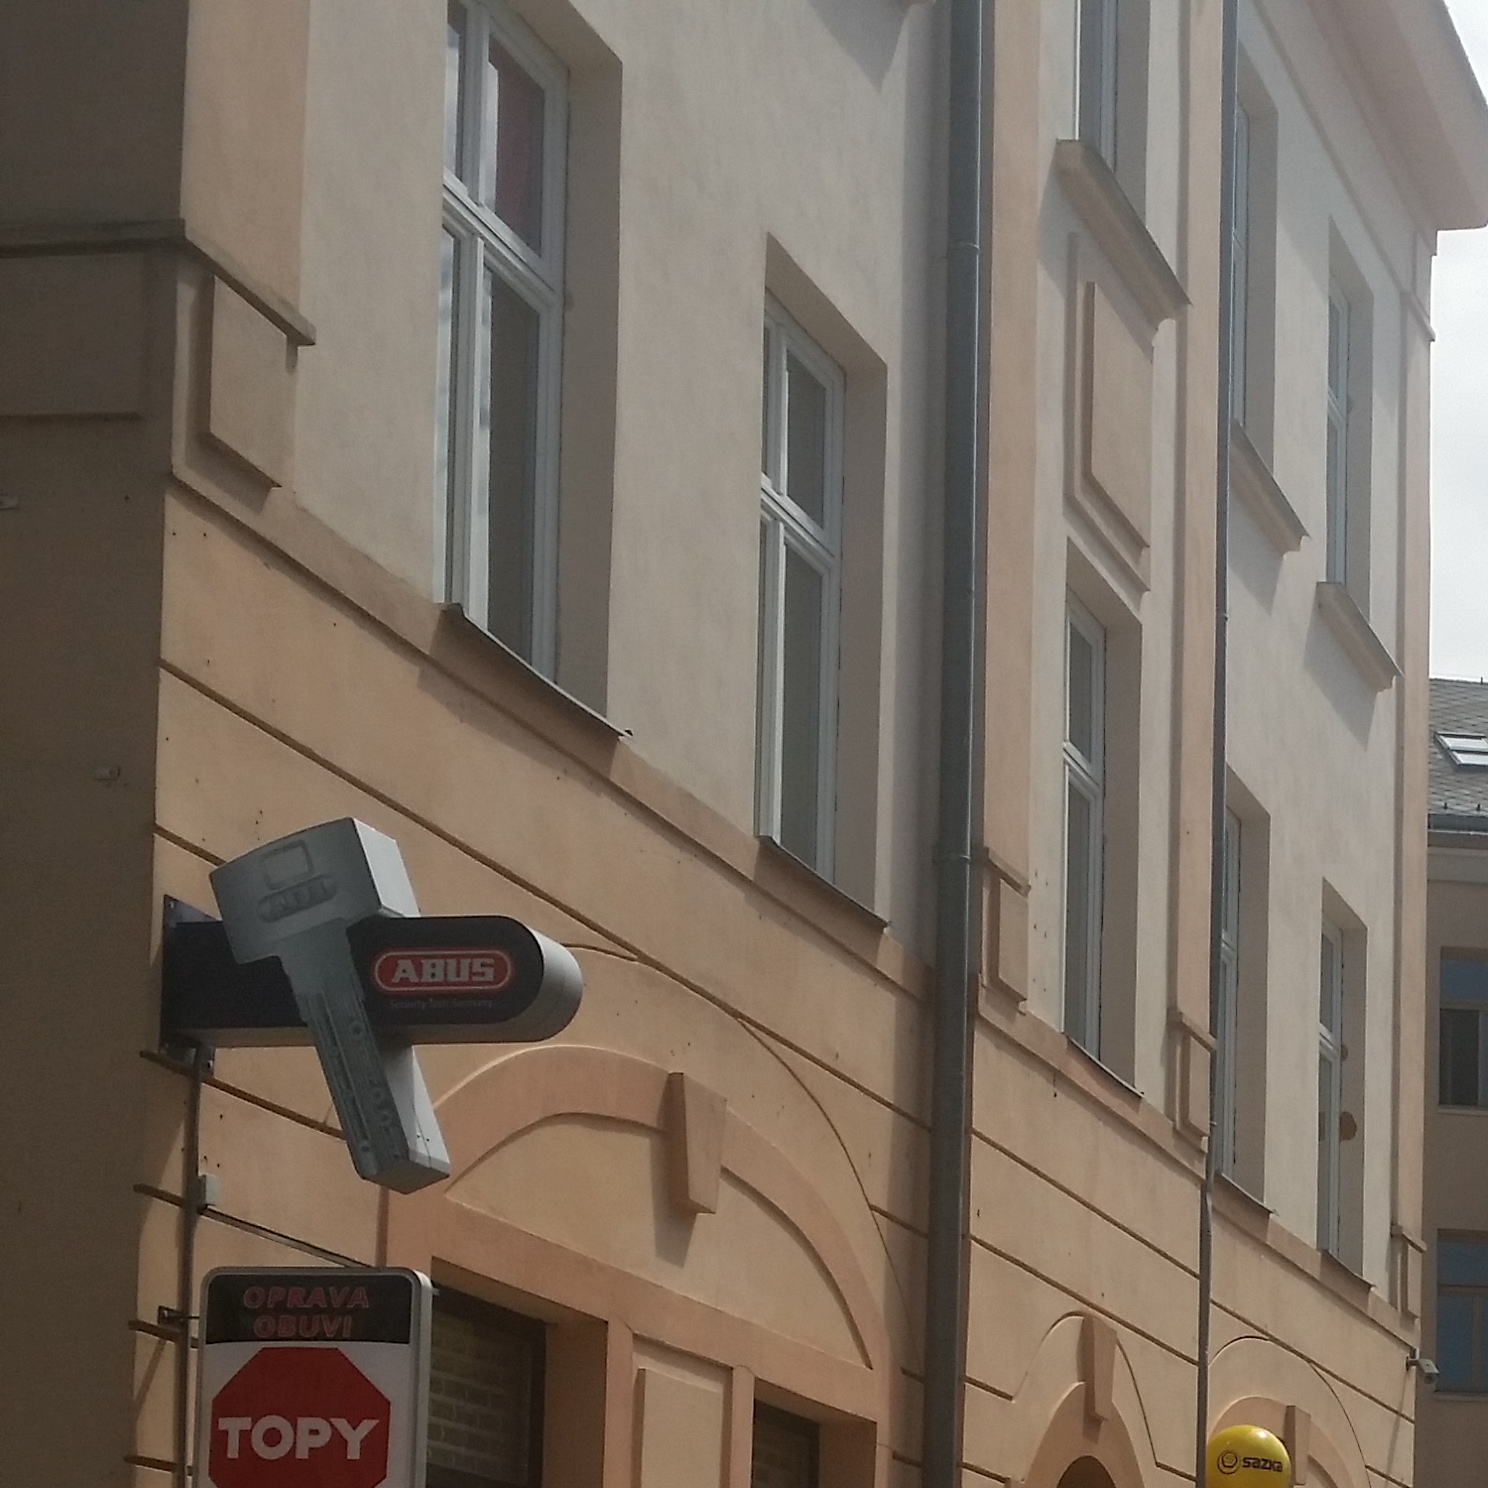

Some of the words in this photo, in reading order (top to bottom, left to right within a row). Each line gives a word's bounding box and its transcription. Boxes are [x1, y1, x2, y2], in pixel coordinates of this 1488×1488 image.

[391, 958, 495, 983] ABUS
[243, 1286, 370, 1309] OPRAVA
[253, 1315, 353, 1338] OBUVI
[218, 1415, 380, 1460] TOPY
